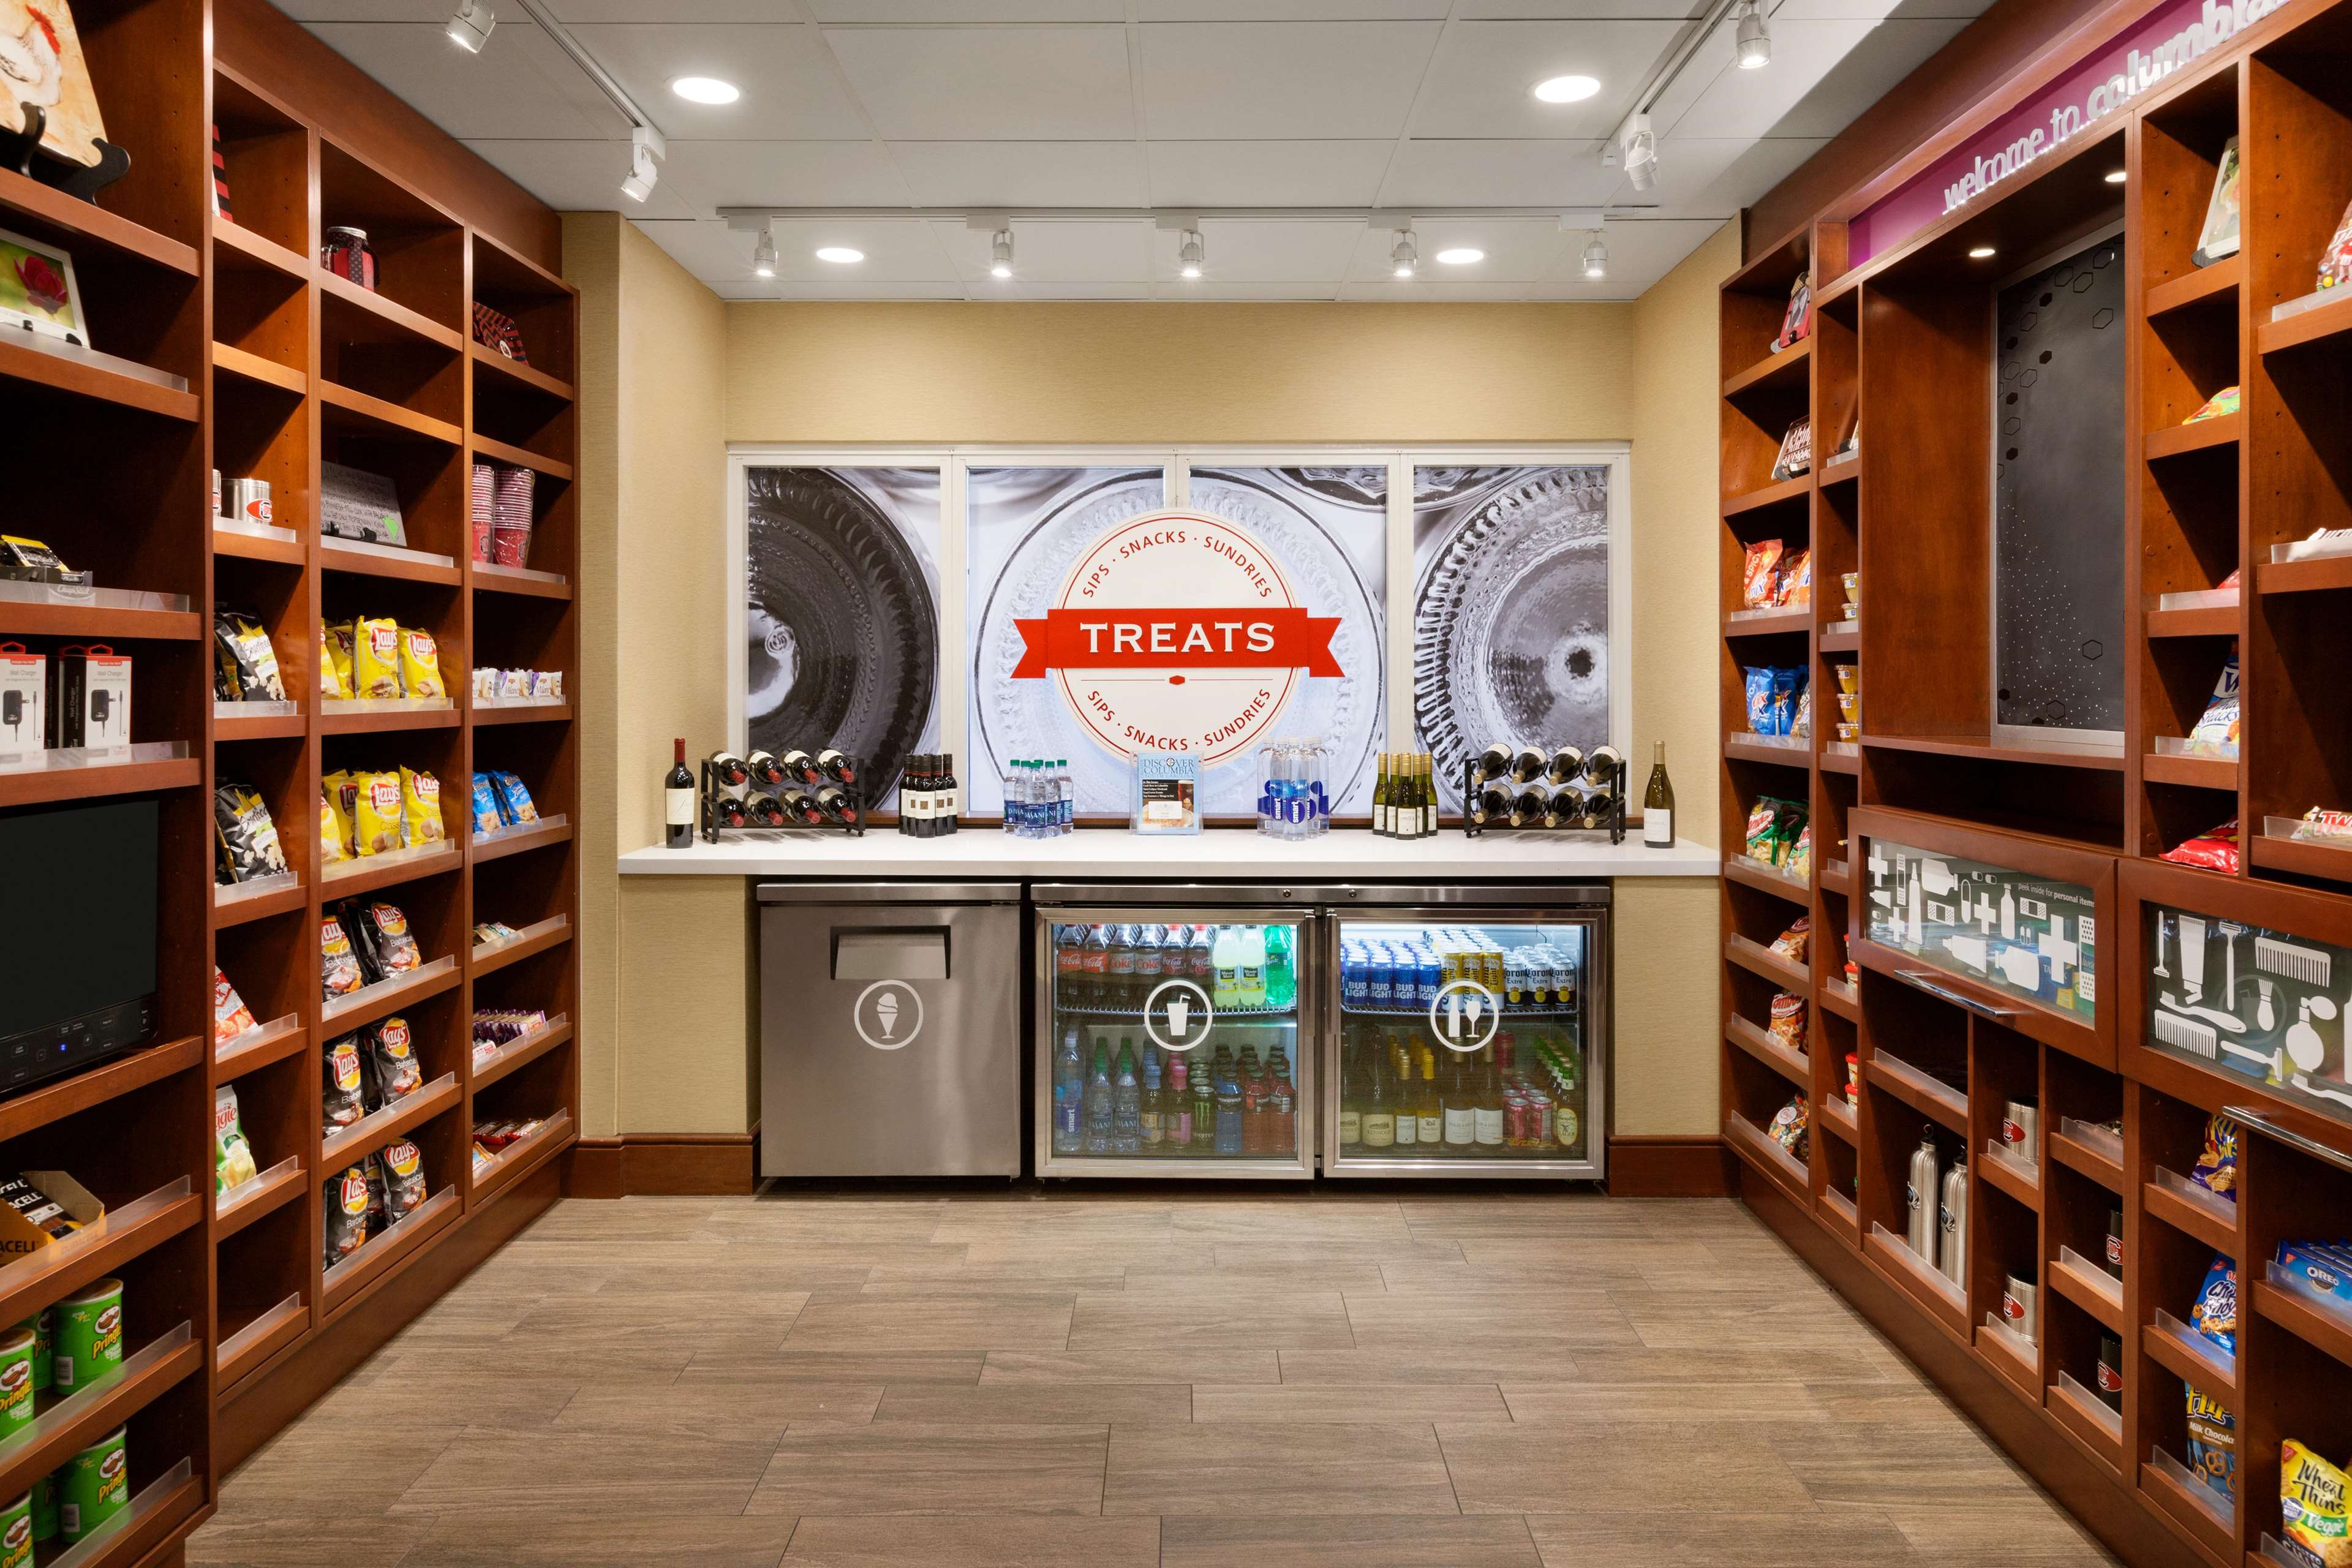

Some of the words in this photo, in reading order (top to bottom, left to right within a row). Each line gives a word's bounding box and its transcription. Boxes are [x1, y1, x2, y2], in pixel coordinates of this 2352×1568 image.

[1944, 128, 2044, 212] welcome
[2050, 105, 2080, 143] to
[1083, 564, 1110, 598] SIPS
[1120, 531, 1186, 559] SNACKS
[1204, 536, 1272, 598] SUNDRIES
[1746, 553, 1762, 577] SPICY
[1080, 622, 1275, 653] TREATS
[1088, 691, 1115, 722] SIPS
[1125, 725, 1188, 751] SNACKS
[1204, 688, 1271, 747] SUNDRIES
[1144, 757, 1194, 767] DISCOVER
[2030, 885, 2045, 895] inside
[2054, 892, 2078, 903] personal
[1370, 989, 1392, 998] LIGHT
[1393, 990, 1416, 999] LIGHT
[1395, 983, 1414, 992] BUD
[1418, 984, 1436, 993] BUD
[383, 1021, 406, 1049] Lay's
[336, 1049, 359, 1082] Lay's
[341, 1090, 362, 1104] Barbe
[1090, 1121, 1110, 1129] ASANI
[1116, 1120, 1136, 1128] ASANI
[390, 1141, 415, 1168] Lay's
[402, 1172, 424, 1187] Barbecu
[2307, 1266, 2339, 1286] OREO
[2207, 1281, 2236, 1302] Chip
[93, 1323, 122, 1360] Pringle
[0, 1379, 32, 1411] Pringle
[2189, 1421, 2204, 1434] Milk
[2205, 1427, 2235, 1444] Chocola
[2297, 1458, 2348, 1501] Wheat
[2292, 1480, 2346, 1515] Thins
[2306, 1512, 2343, 1537] Veggie
